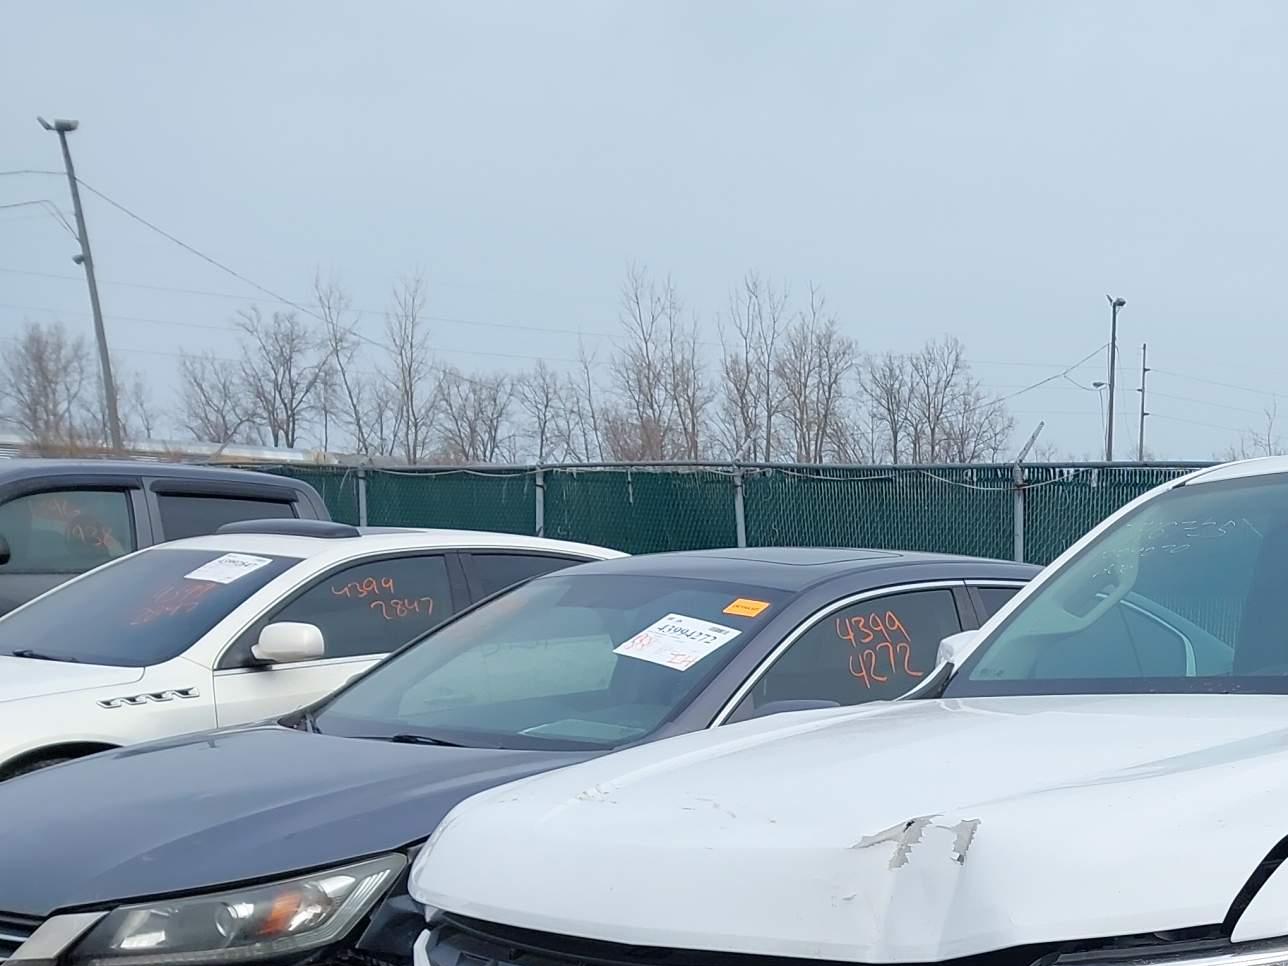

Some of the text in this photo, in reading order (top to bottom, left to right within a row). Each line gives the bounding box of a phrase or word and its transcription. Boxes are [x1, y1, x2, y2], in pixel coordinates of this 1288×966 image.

[331, 576, 395, 598] 4399
[370, 596, 433, 620] 2847
[836, 611, 912, 648] 4399
[849, 642, 924, 689] 4272
